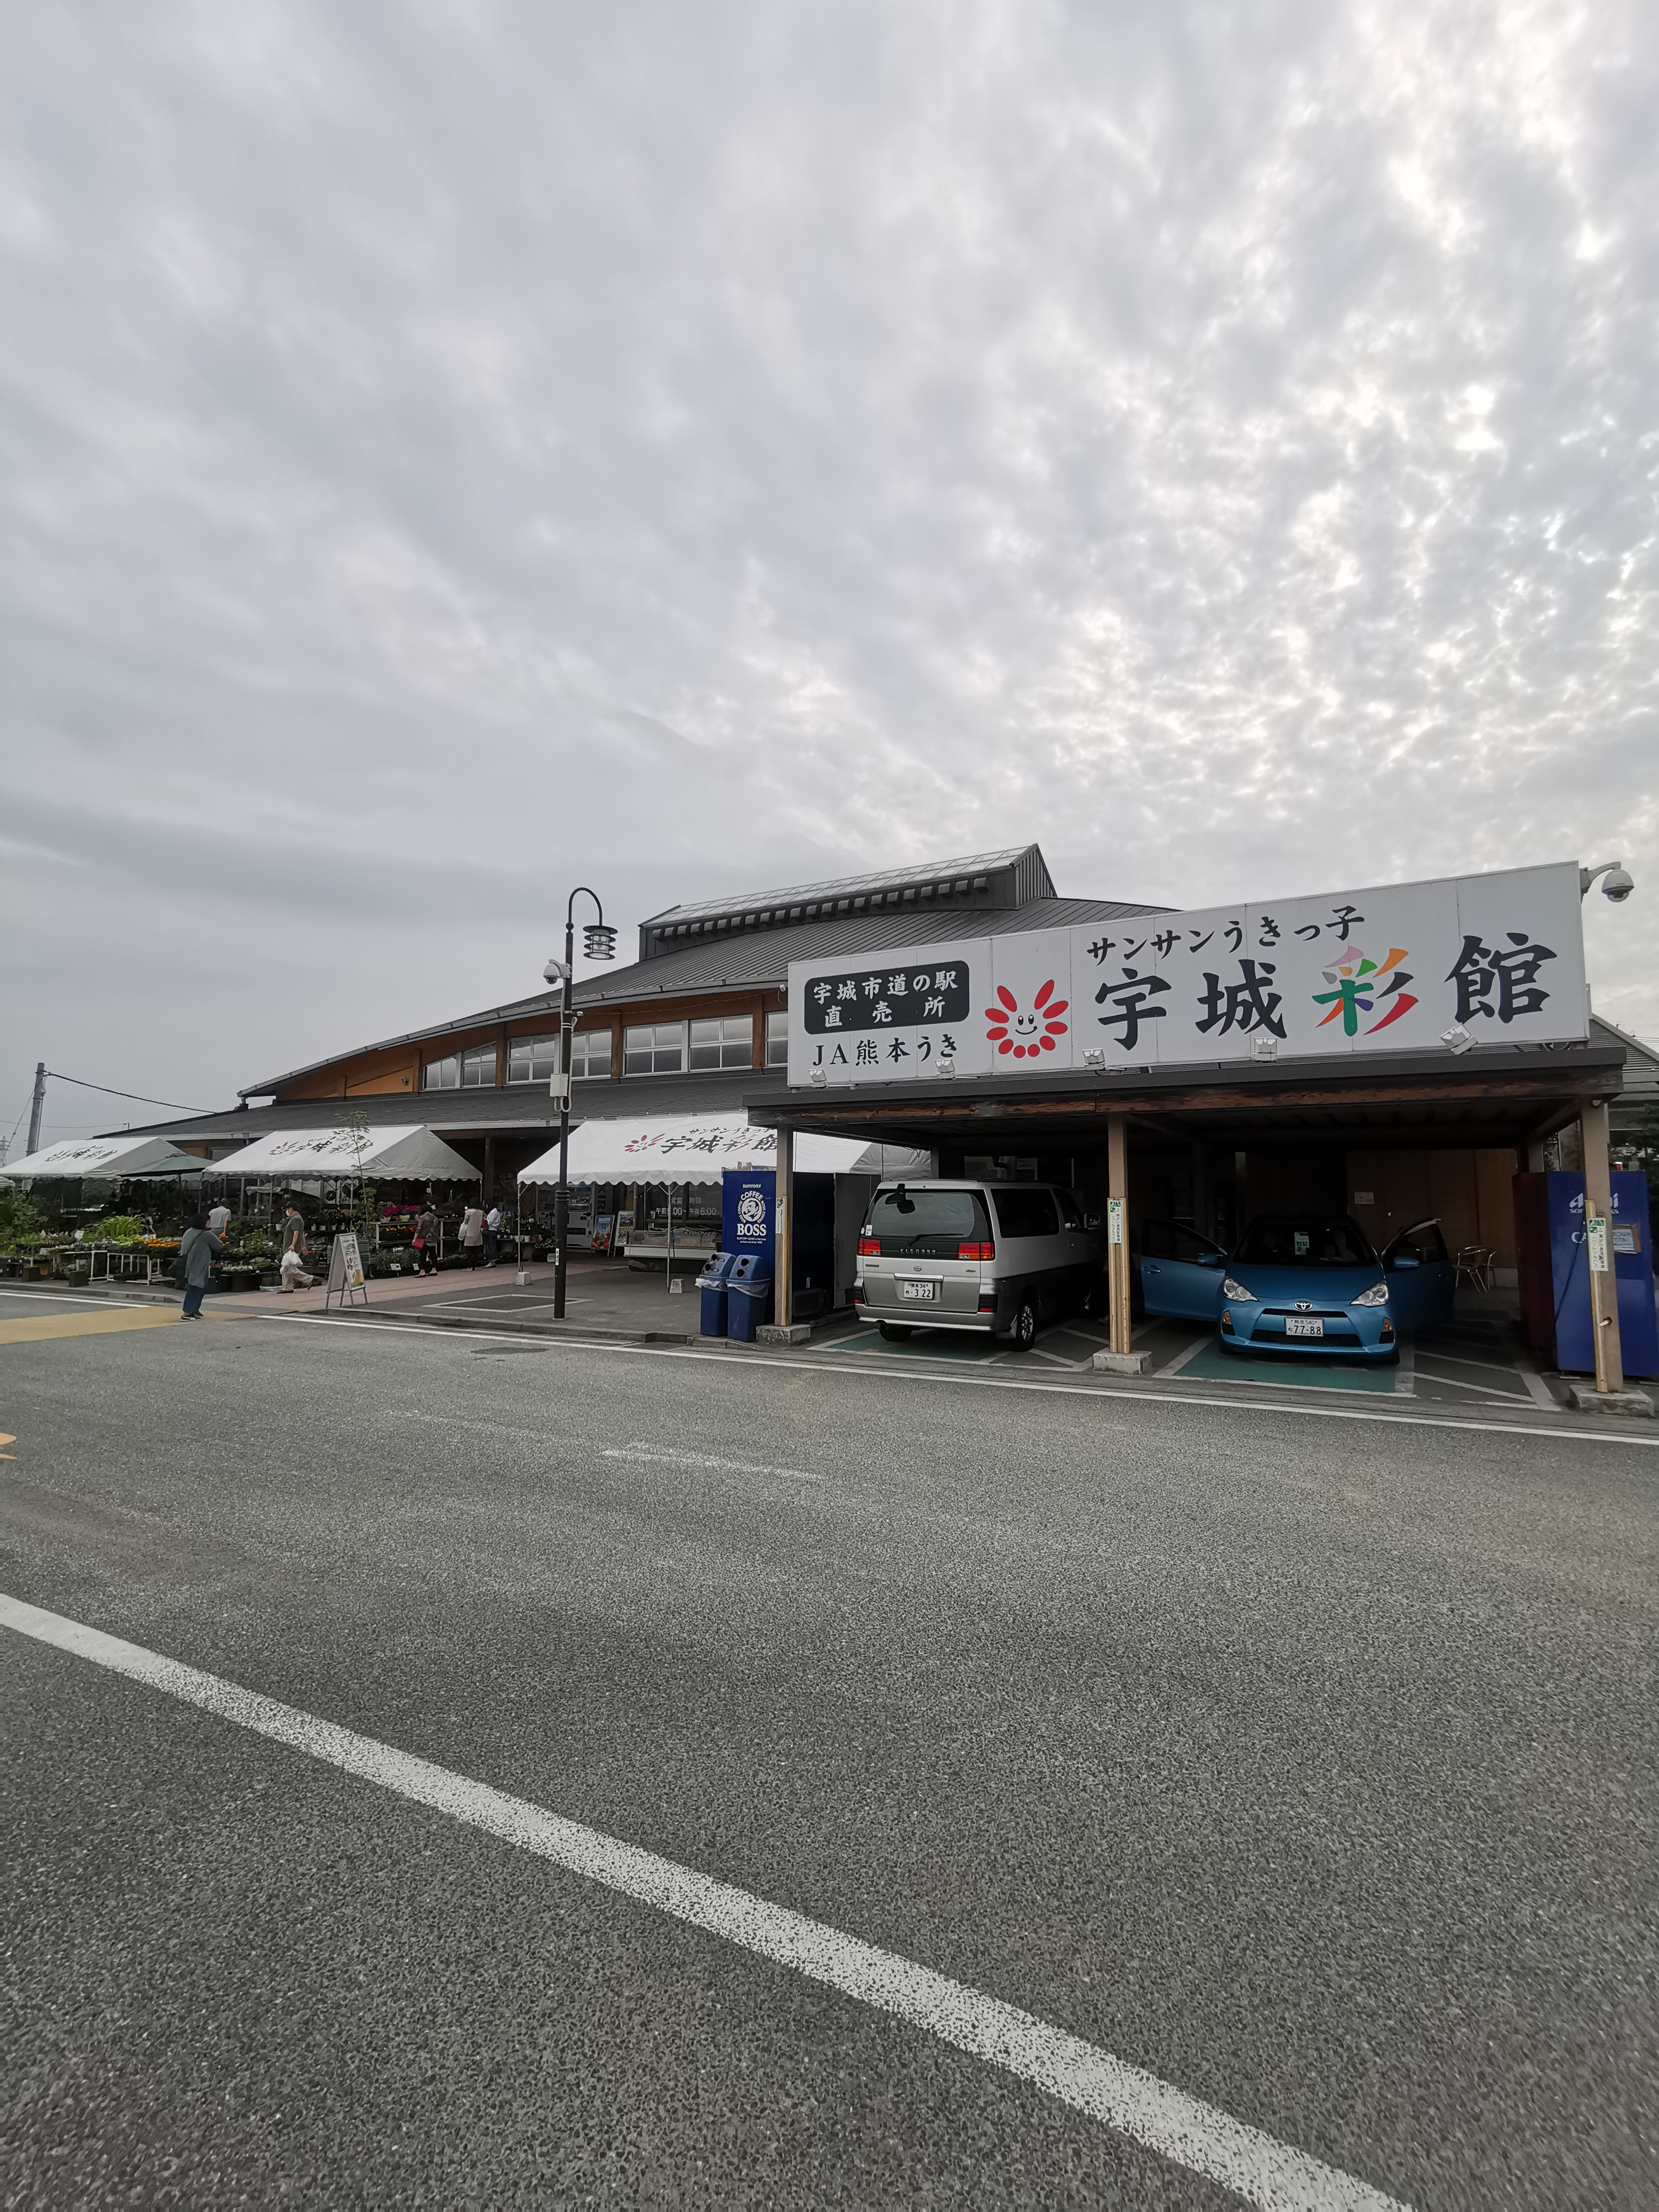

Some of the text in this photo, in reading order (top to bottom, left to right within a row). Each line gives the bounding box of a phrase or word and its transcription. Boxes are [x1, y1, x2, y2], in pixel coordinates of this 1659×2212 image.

[1087, 906, 1364, 966] サンサンうきっ子
[813, 970, 958, 1005] 宇城市道の駅
[1094, 932, 1557, 1051] 宇城彩館
[824, 996, 946, 1028] 直売所
[812, 1033, 957, 1066] JA熊本うき
[661, 1134, 777, 1154] 宇城彩館
[741, 1191, 763, 1201] COFFEE
[736, 1224, 766, 1236] BOSS
[1294, 1325, 1321, 1335] 77-88
